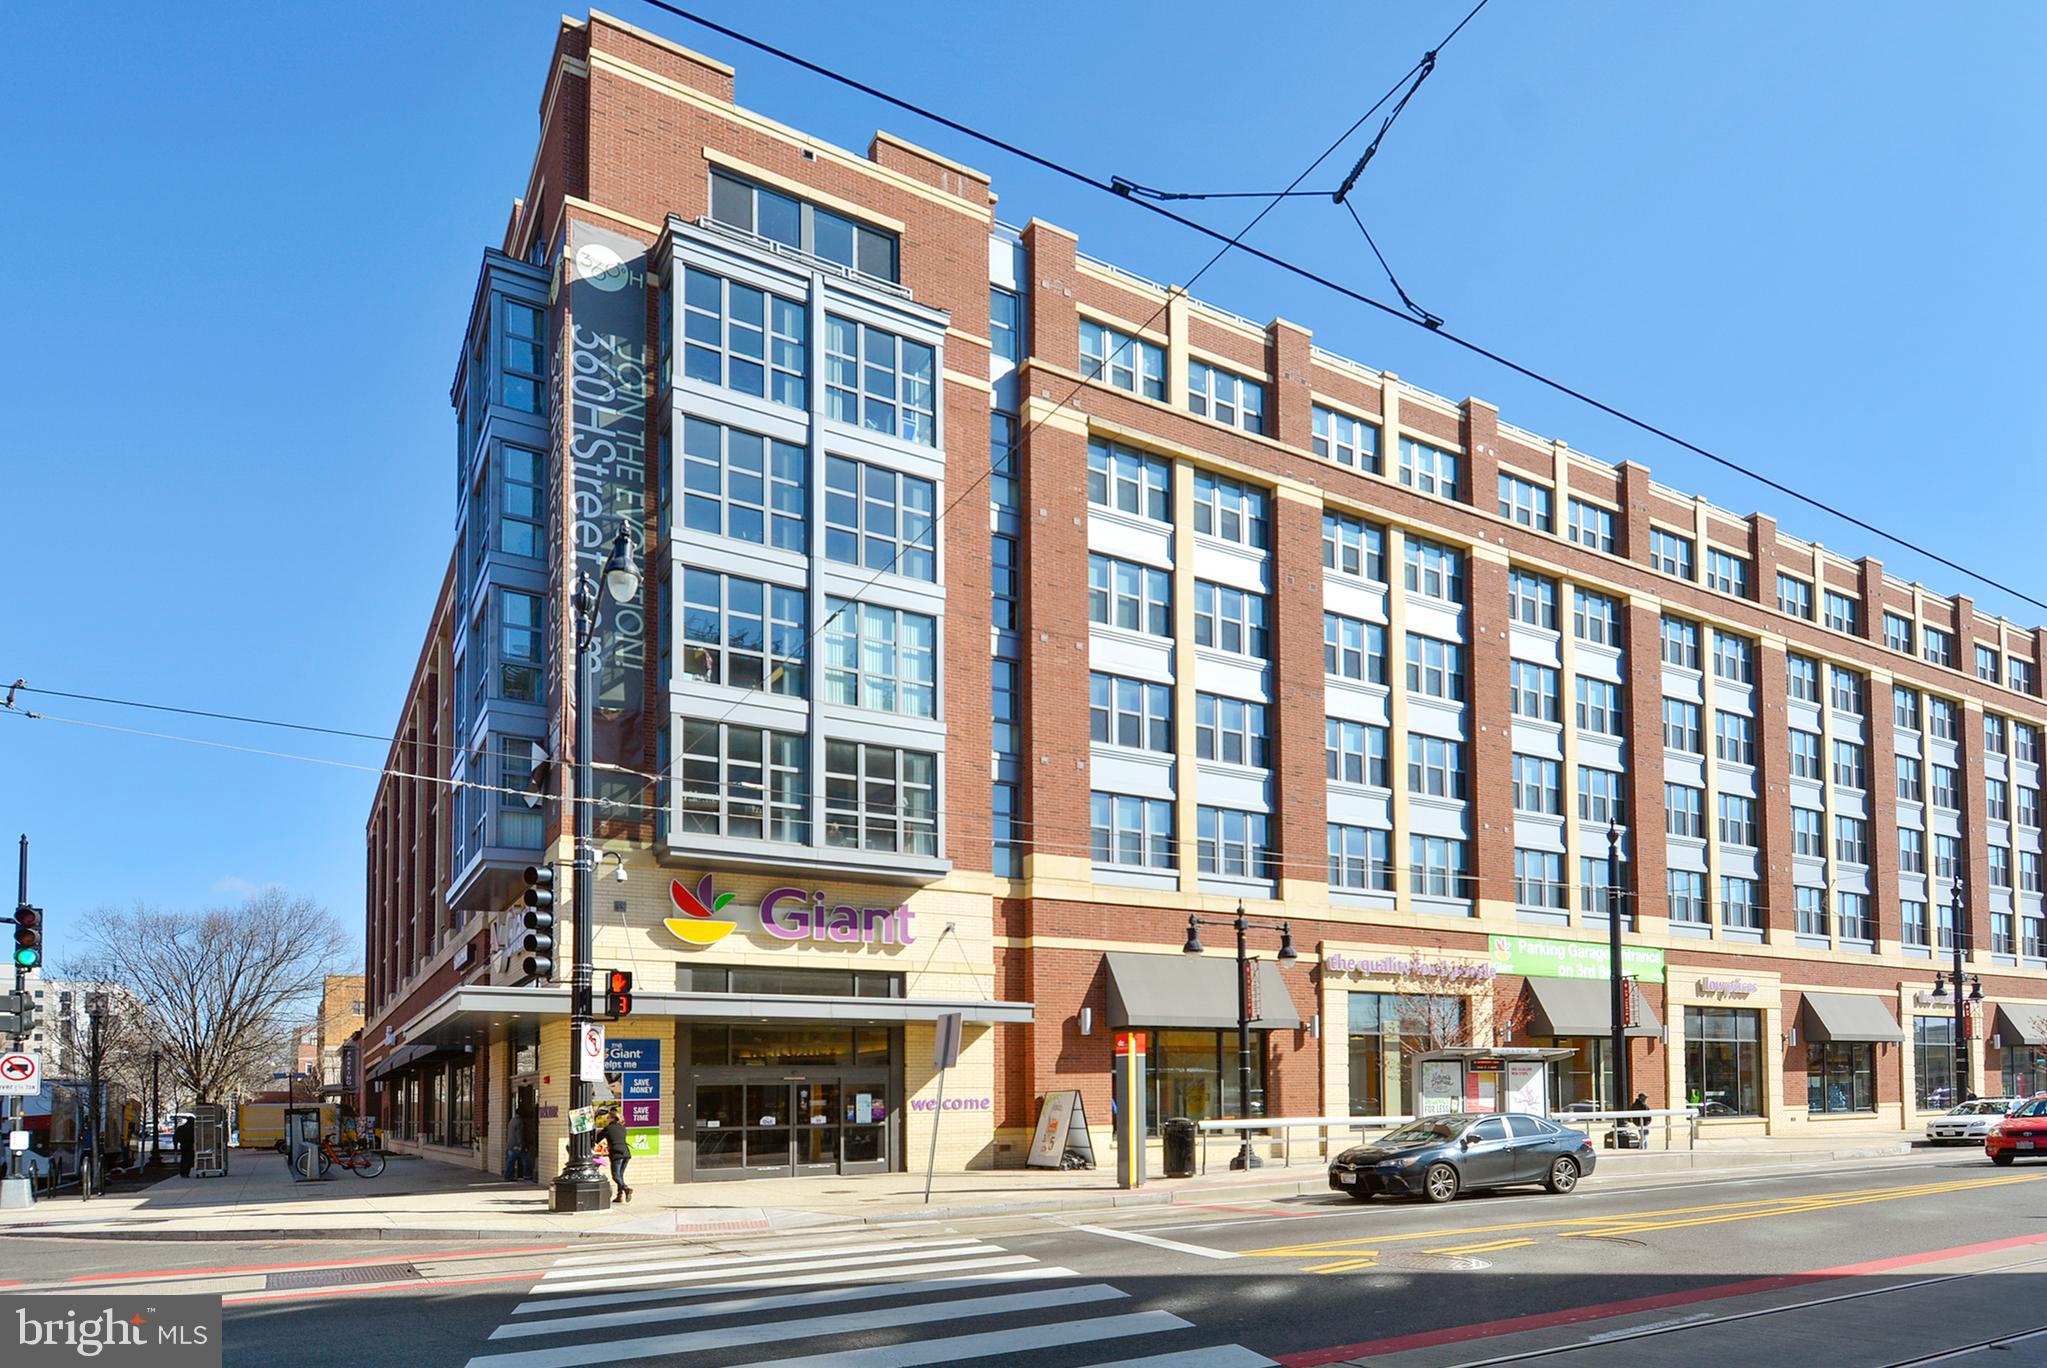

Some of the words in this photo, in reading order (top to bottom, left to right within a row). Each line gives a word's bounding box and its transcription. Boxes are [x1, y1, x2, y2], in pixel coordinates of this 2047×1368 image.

[616, 344, 645, 420] JOIN
[615, 430, 645, 484] THE
[759, 887, 917, 945] Giant
[1518, 941, 1565, 960] Parking
[1569, 944, 1611, 962] Garage
[1621, 949, 1662, 964] ntrance
[1327, 954, 1355, 971] the
[1558, 965, 1573, 976] on
[1576, 964, 1596, 977] 3rd
[618, 996, 629, 1014] 3
[610, 1048, 641, 1059] Giant
[604, 1060, 622, 1070] elps
[623, 1061, 638, 1069] me
[633, 1078, 650, 1087] SAVE
[629, 1086, 654, 1094] MONEY
[632, 1106, 650, 1114] SAVE
[910, 1097, 990, 1112] wecome
[632, 1114, 650, 1122] TIME
